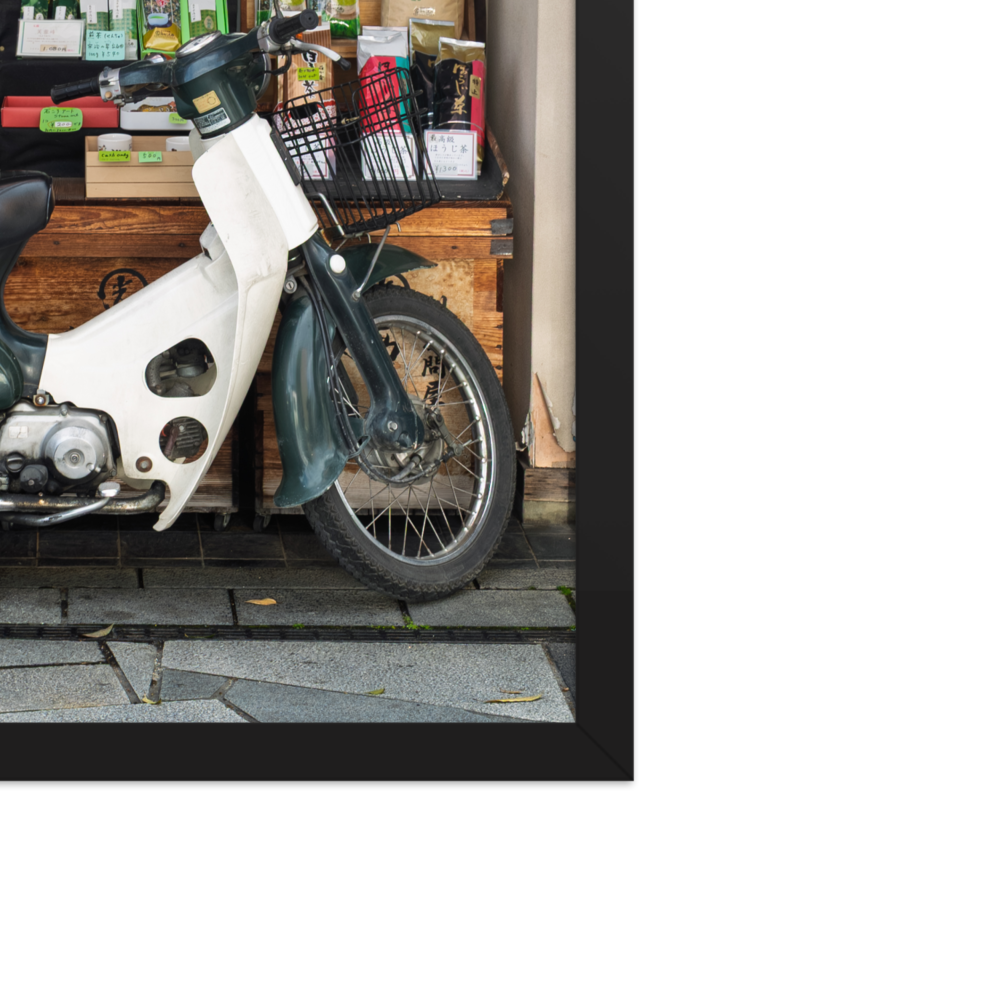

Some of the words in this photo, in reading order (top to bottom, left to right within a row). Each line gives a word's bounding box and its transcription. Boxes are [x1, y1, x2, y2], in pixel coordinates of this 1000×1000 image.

[452, 63, 469, 115] ほうじ茶
[430, 144, 468, 154] ほうじ茶
[435, 165, 457, 173] ¥1300
